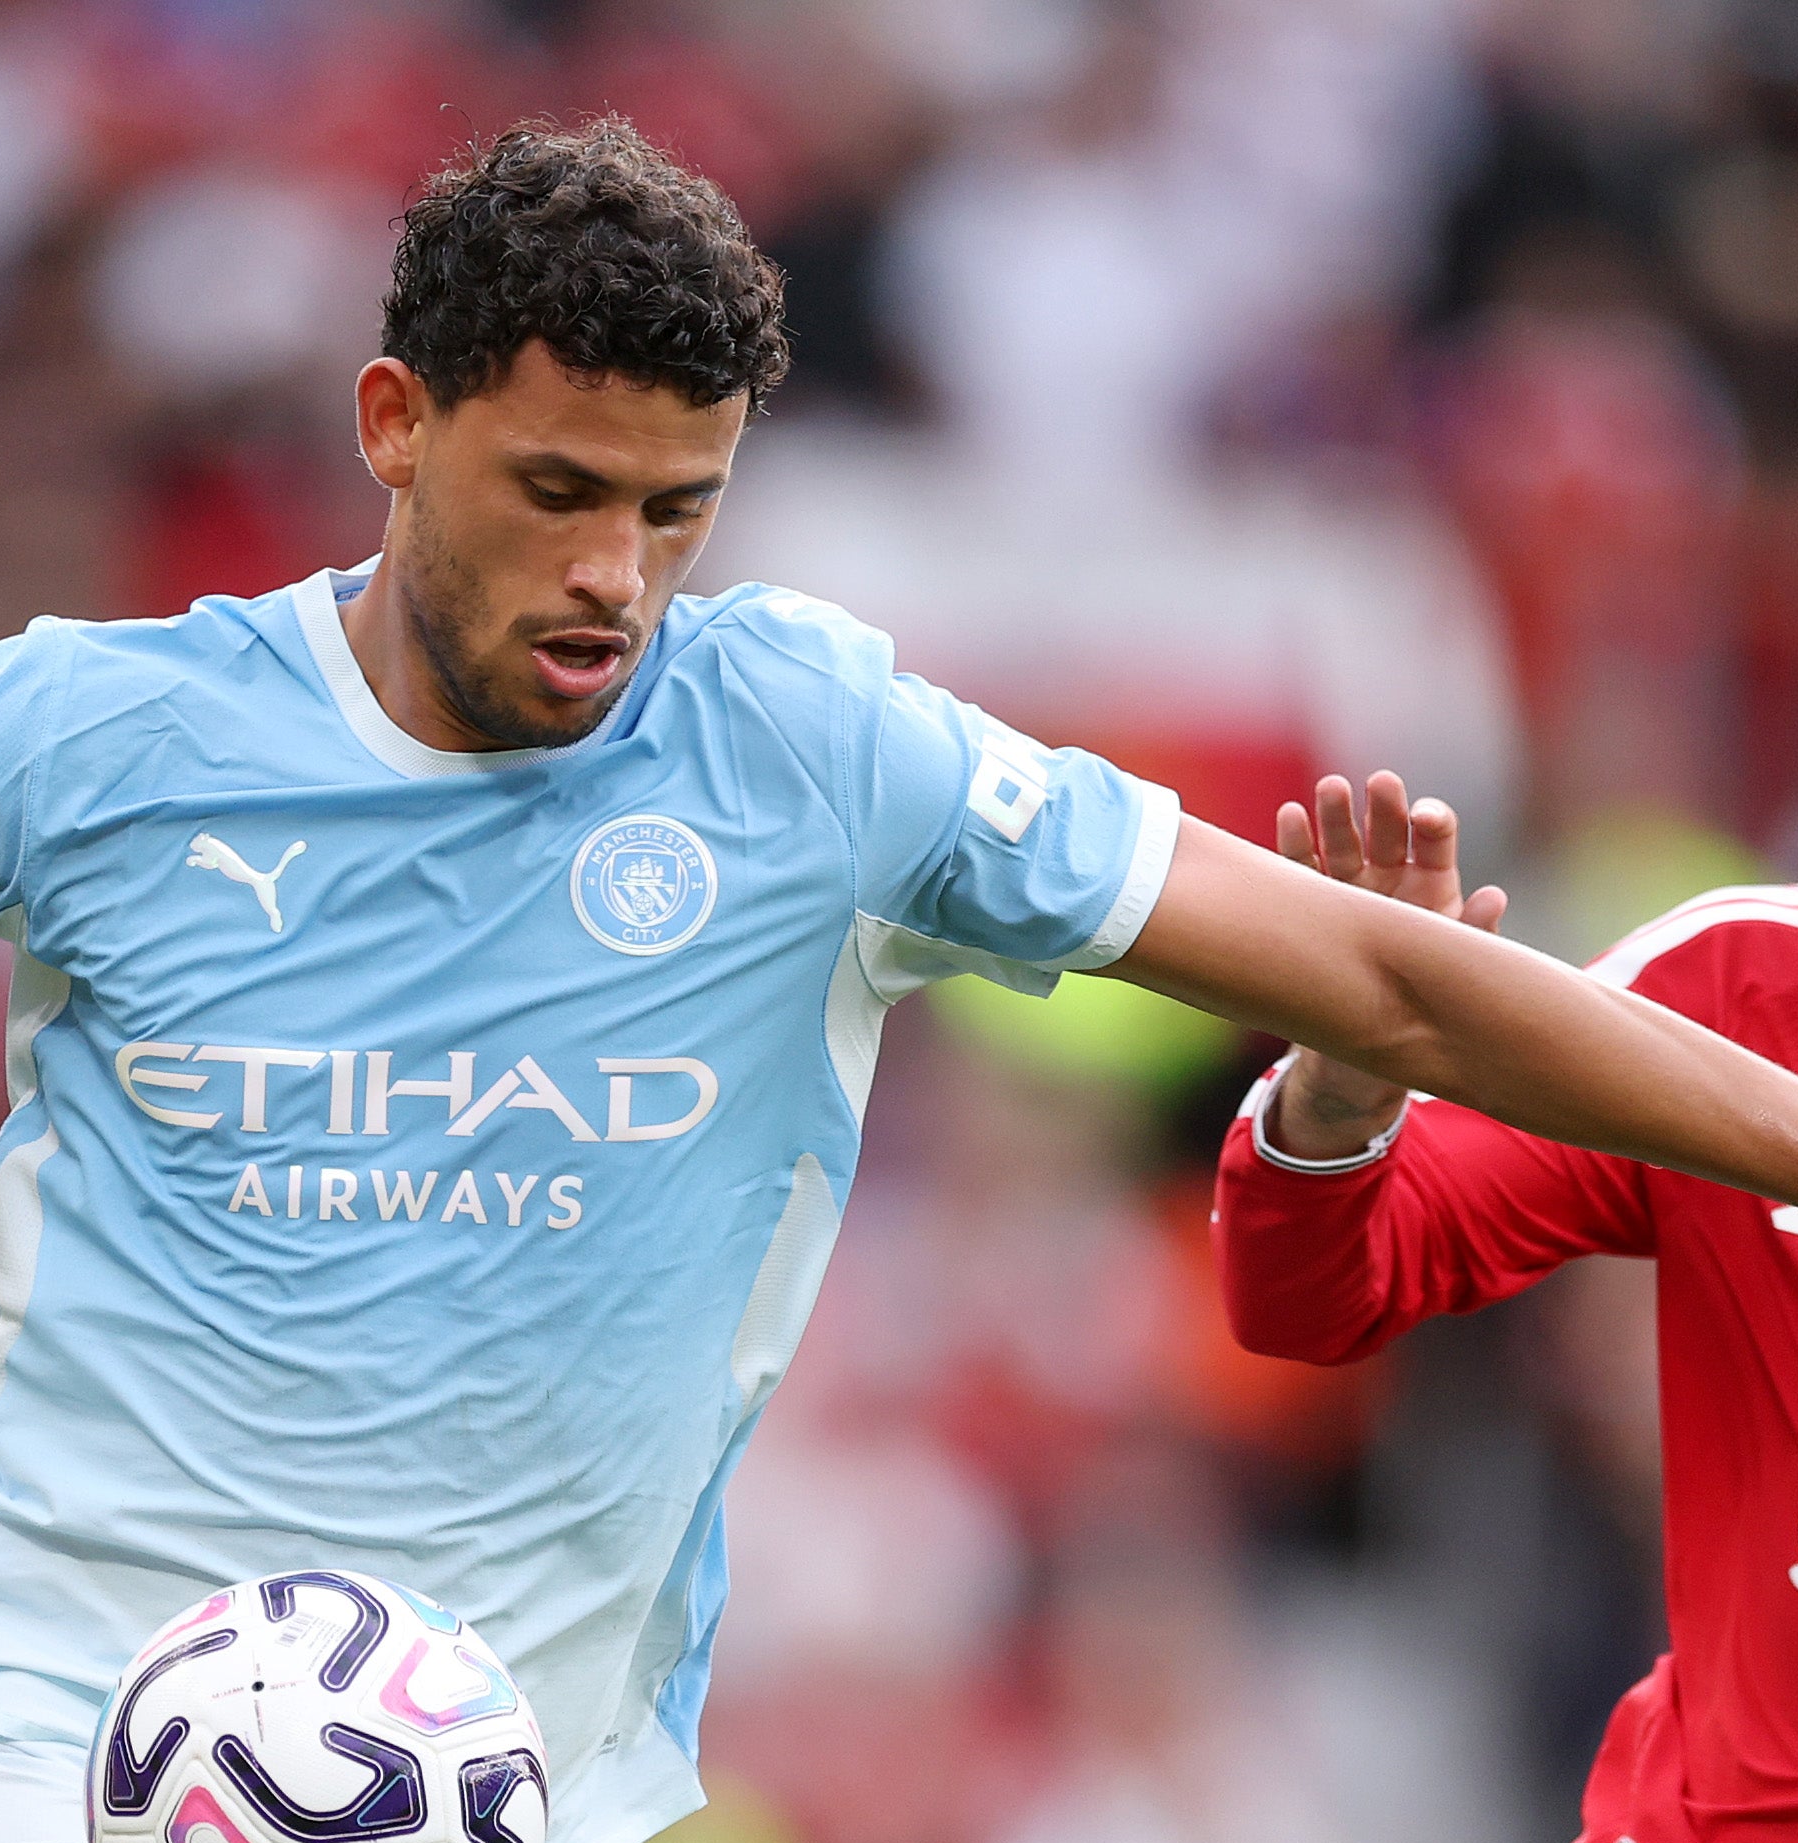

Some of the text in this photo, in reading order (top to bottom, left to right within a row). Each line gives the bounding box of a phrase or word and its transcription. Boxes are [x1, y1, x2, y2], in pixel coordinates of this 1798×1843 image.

[590, 826, 700, 869] MANCHESTER
[622, 928, 662, 942] CITY
[114, 1041, 720, 1143] ETIHAD
[227, 1162, 584, 1231] AIRWAYS
